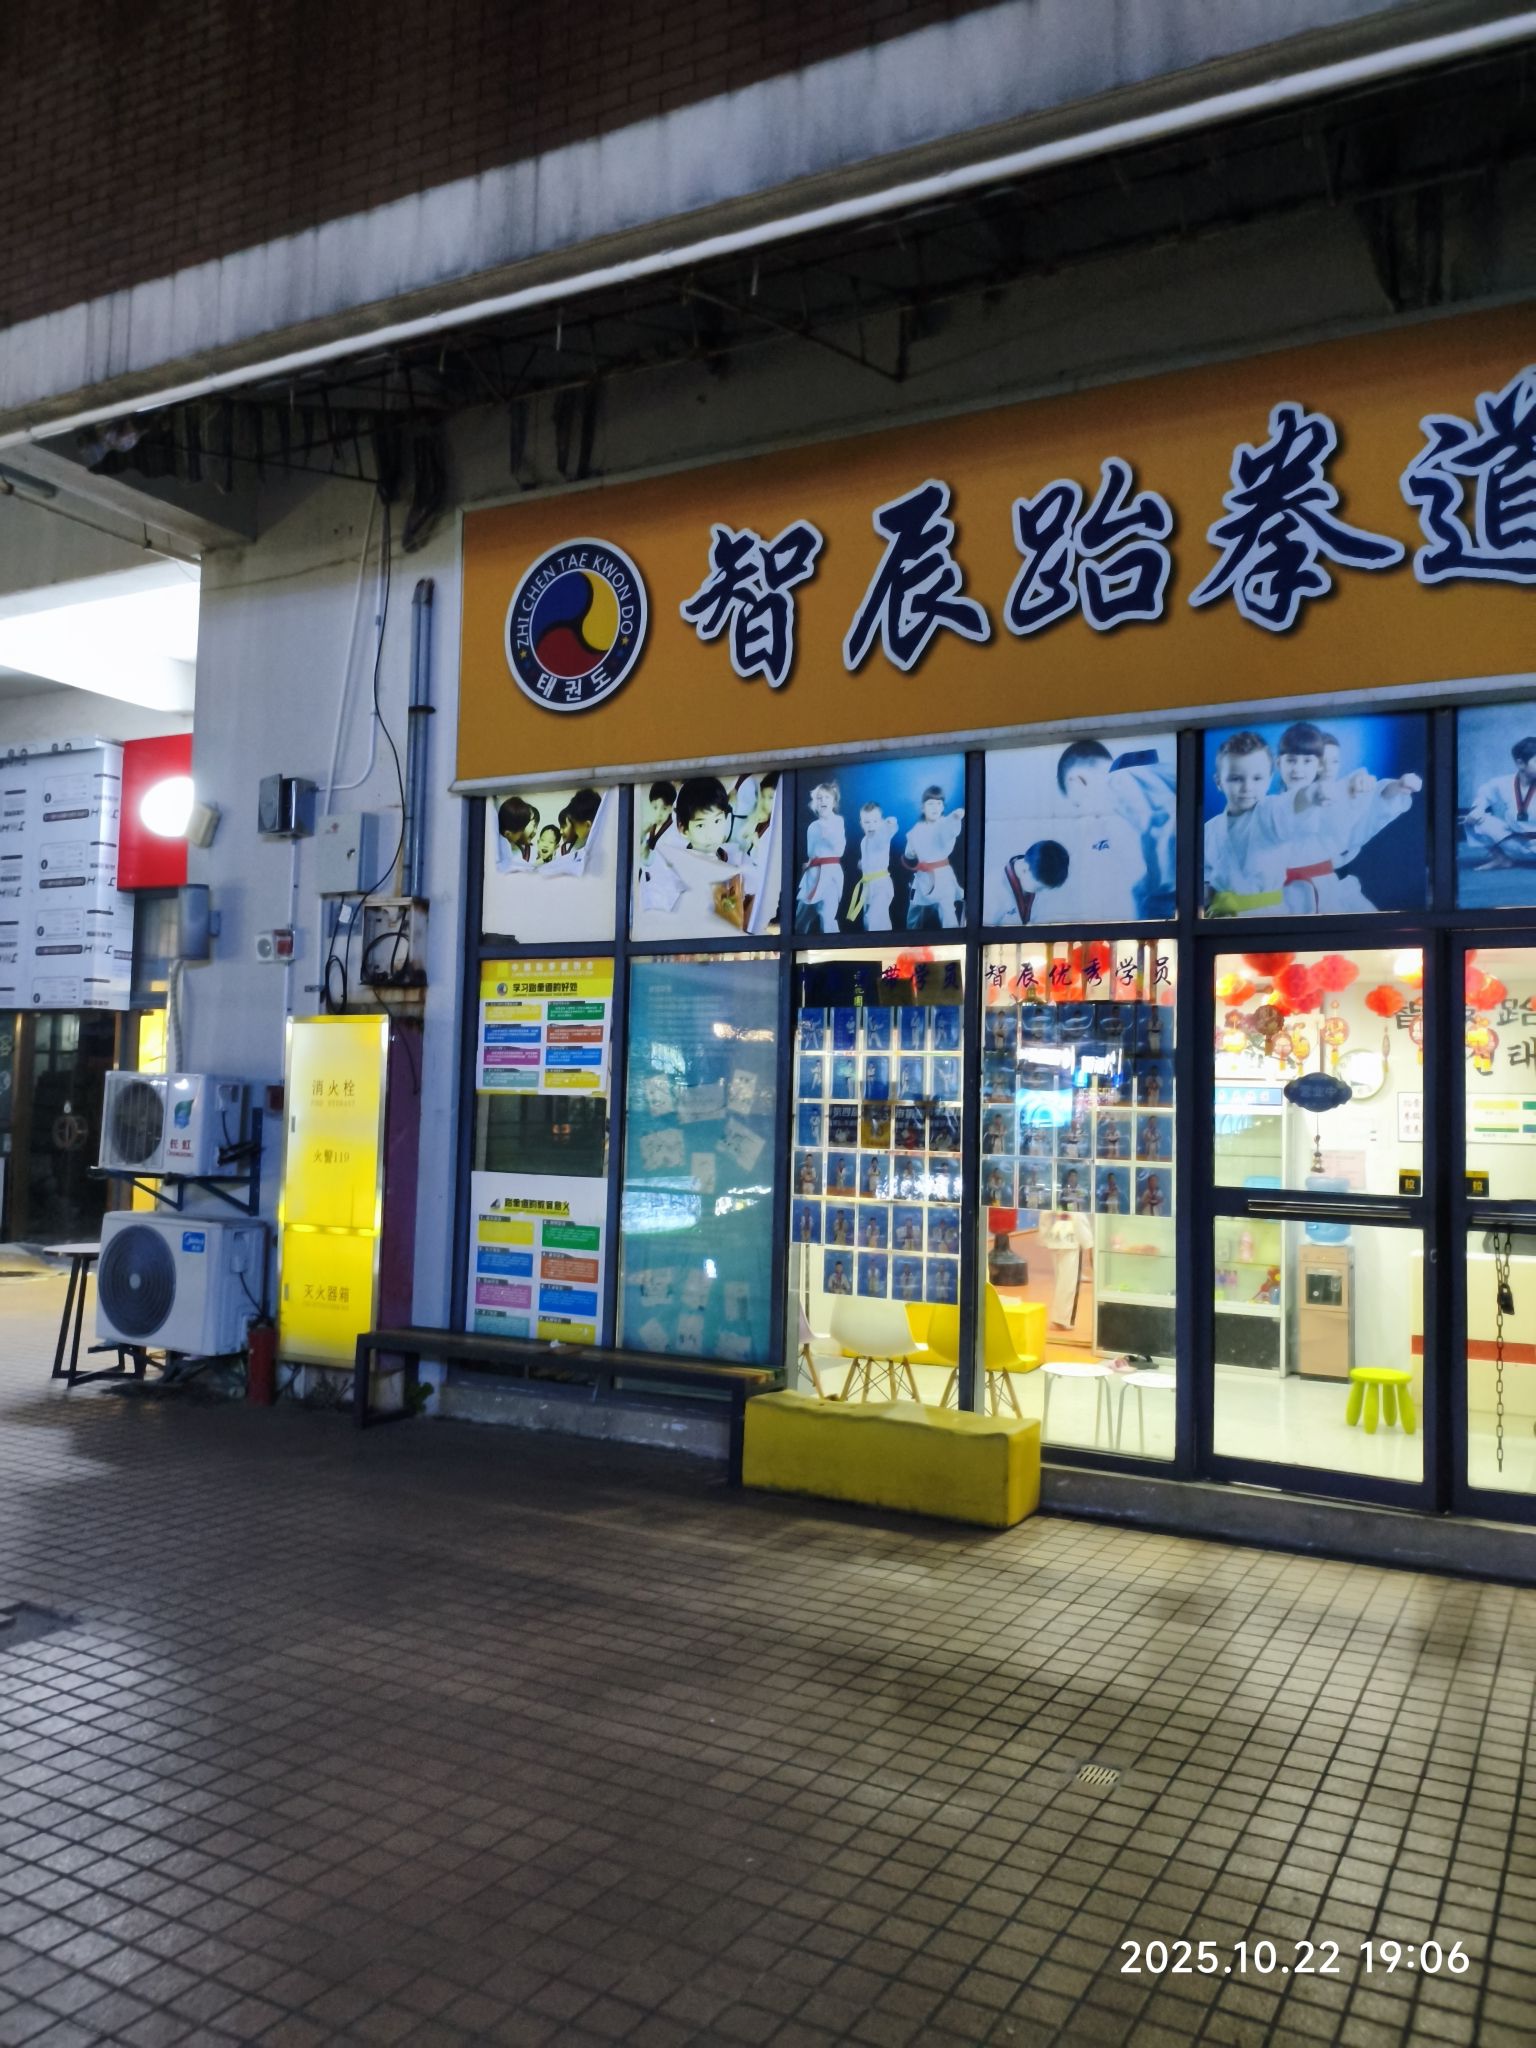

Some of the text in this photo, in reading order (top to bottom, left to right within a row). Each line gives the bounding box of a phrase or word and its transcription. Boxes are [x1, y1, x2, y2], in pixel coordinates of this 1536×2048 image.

[517, 552, 634, 649] ZHI CHEN TAE KWON DO
[537, 667, 611, 701] 태권도
[984, 956, 1172, 988] 智辰优秀学员
[312, 1080, 355, 1096] 消火栓
